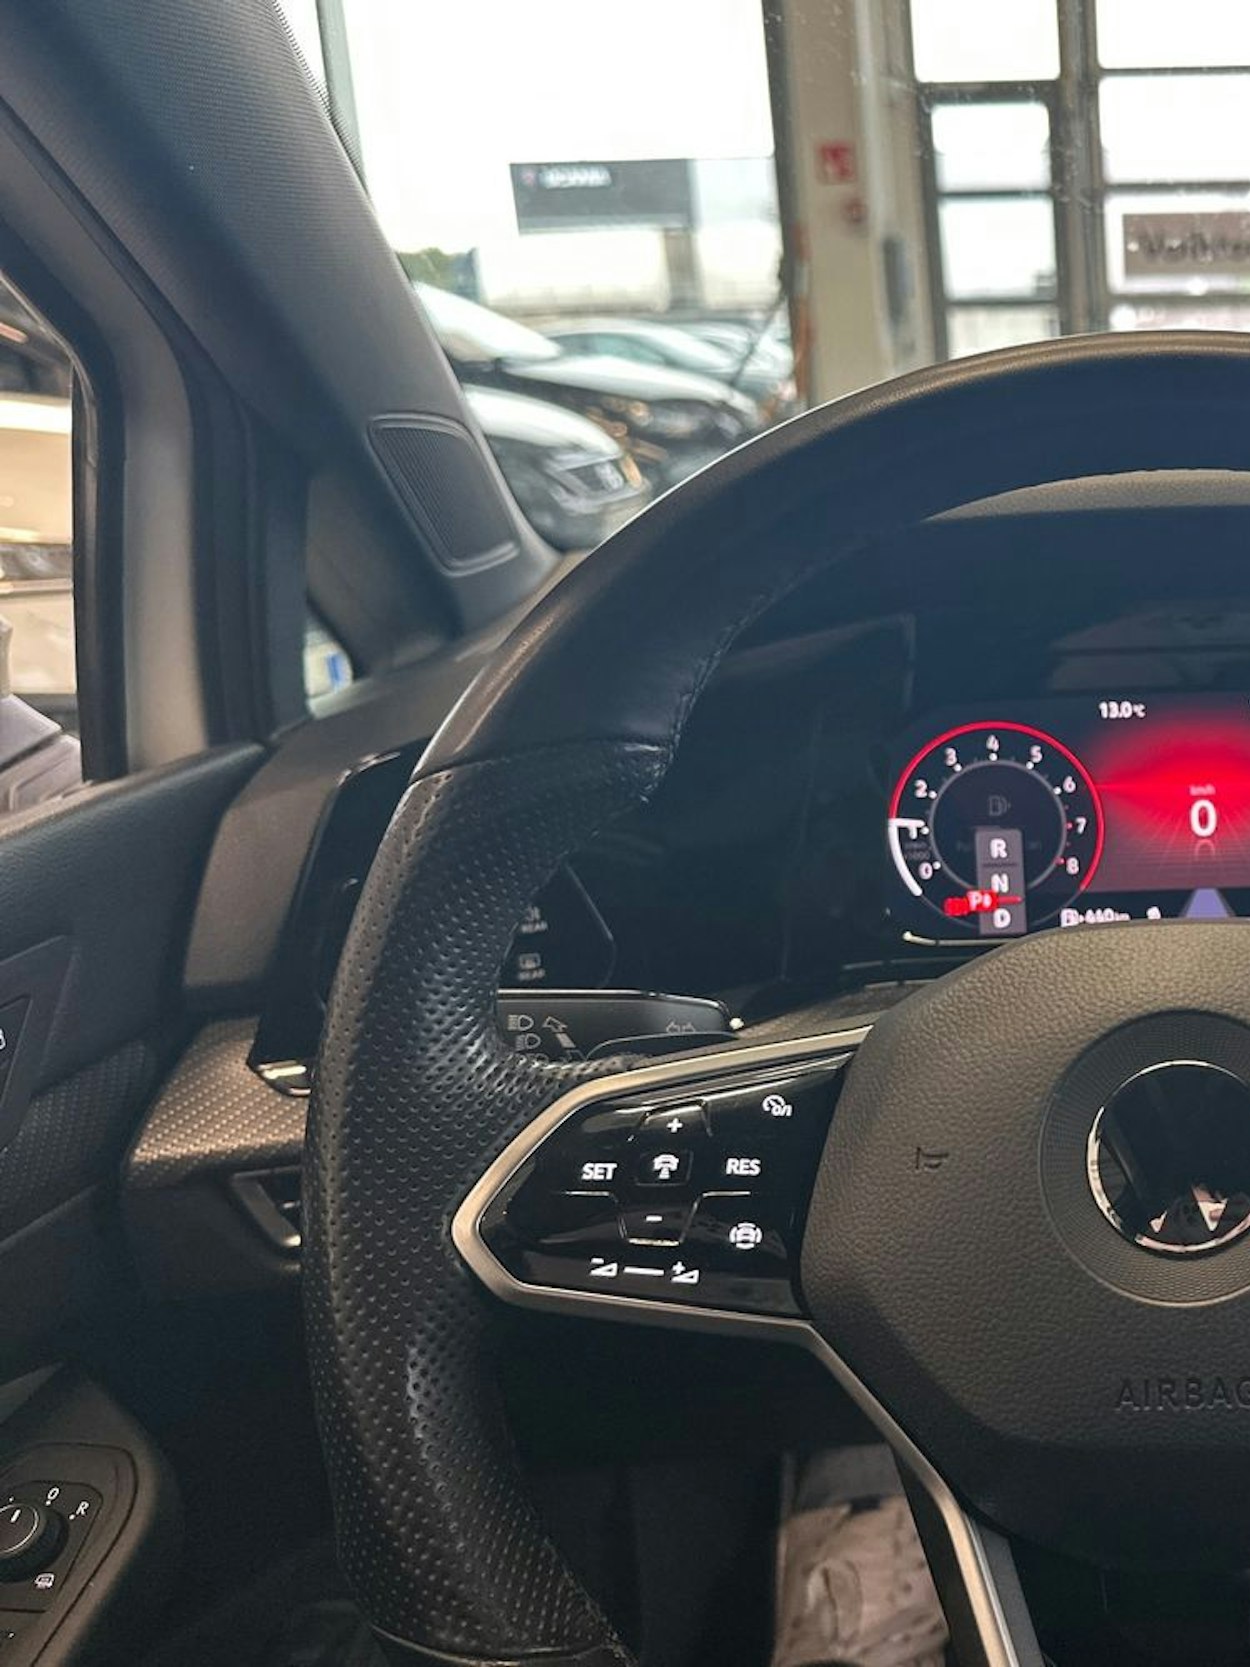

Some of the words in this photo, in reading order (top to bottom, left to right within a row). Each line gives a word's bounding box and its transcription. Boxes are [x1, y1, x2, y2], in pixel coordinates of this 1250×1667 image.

[987, 735, 999, 751] 4
[945, 748, 957, 765] 3
[1030, 745, 1043, 762] 5
[915, 780, 928, 797] 2
[1063, 776, 1076, 793] 6
[1076, 818, 1086, 833] 7
[1191, 800, 1217, 837] 0
[991, 839, 1007, 858] R
[1066, 857, 1079, 874] 8
[991, 874, 1009, 893] N
[994, 909, 1011, 928] D
[582, 1163, 617, 1180] SET
[726, 1158, 760, 1175] RES
[76, 1501, 89, 1515] R
